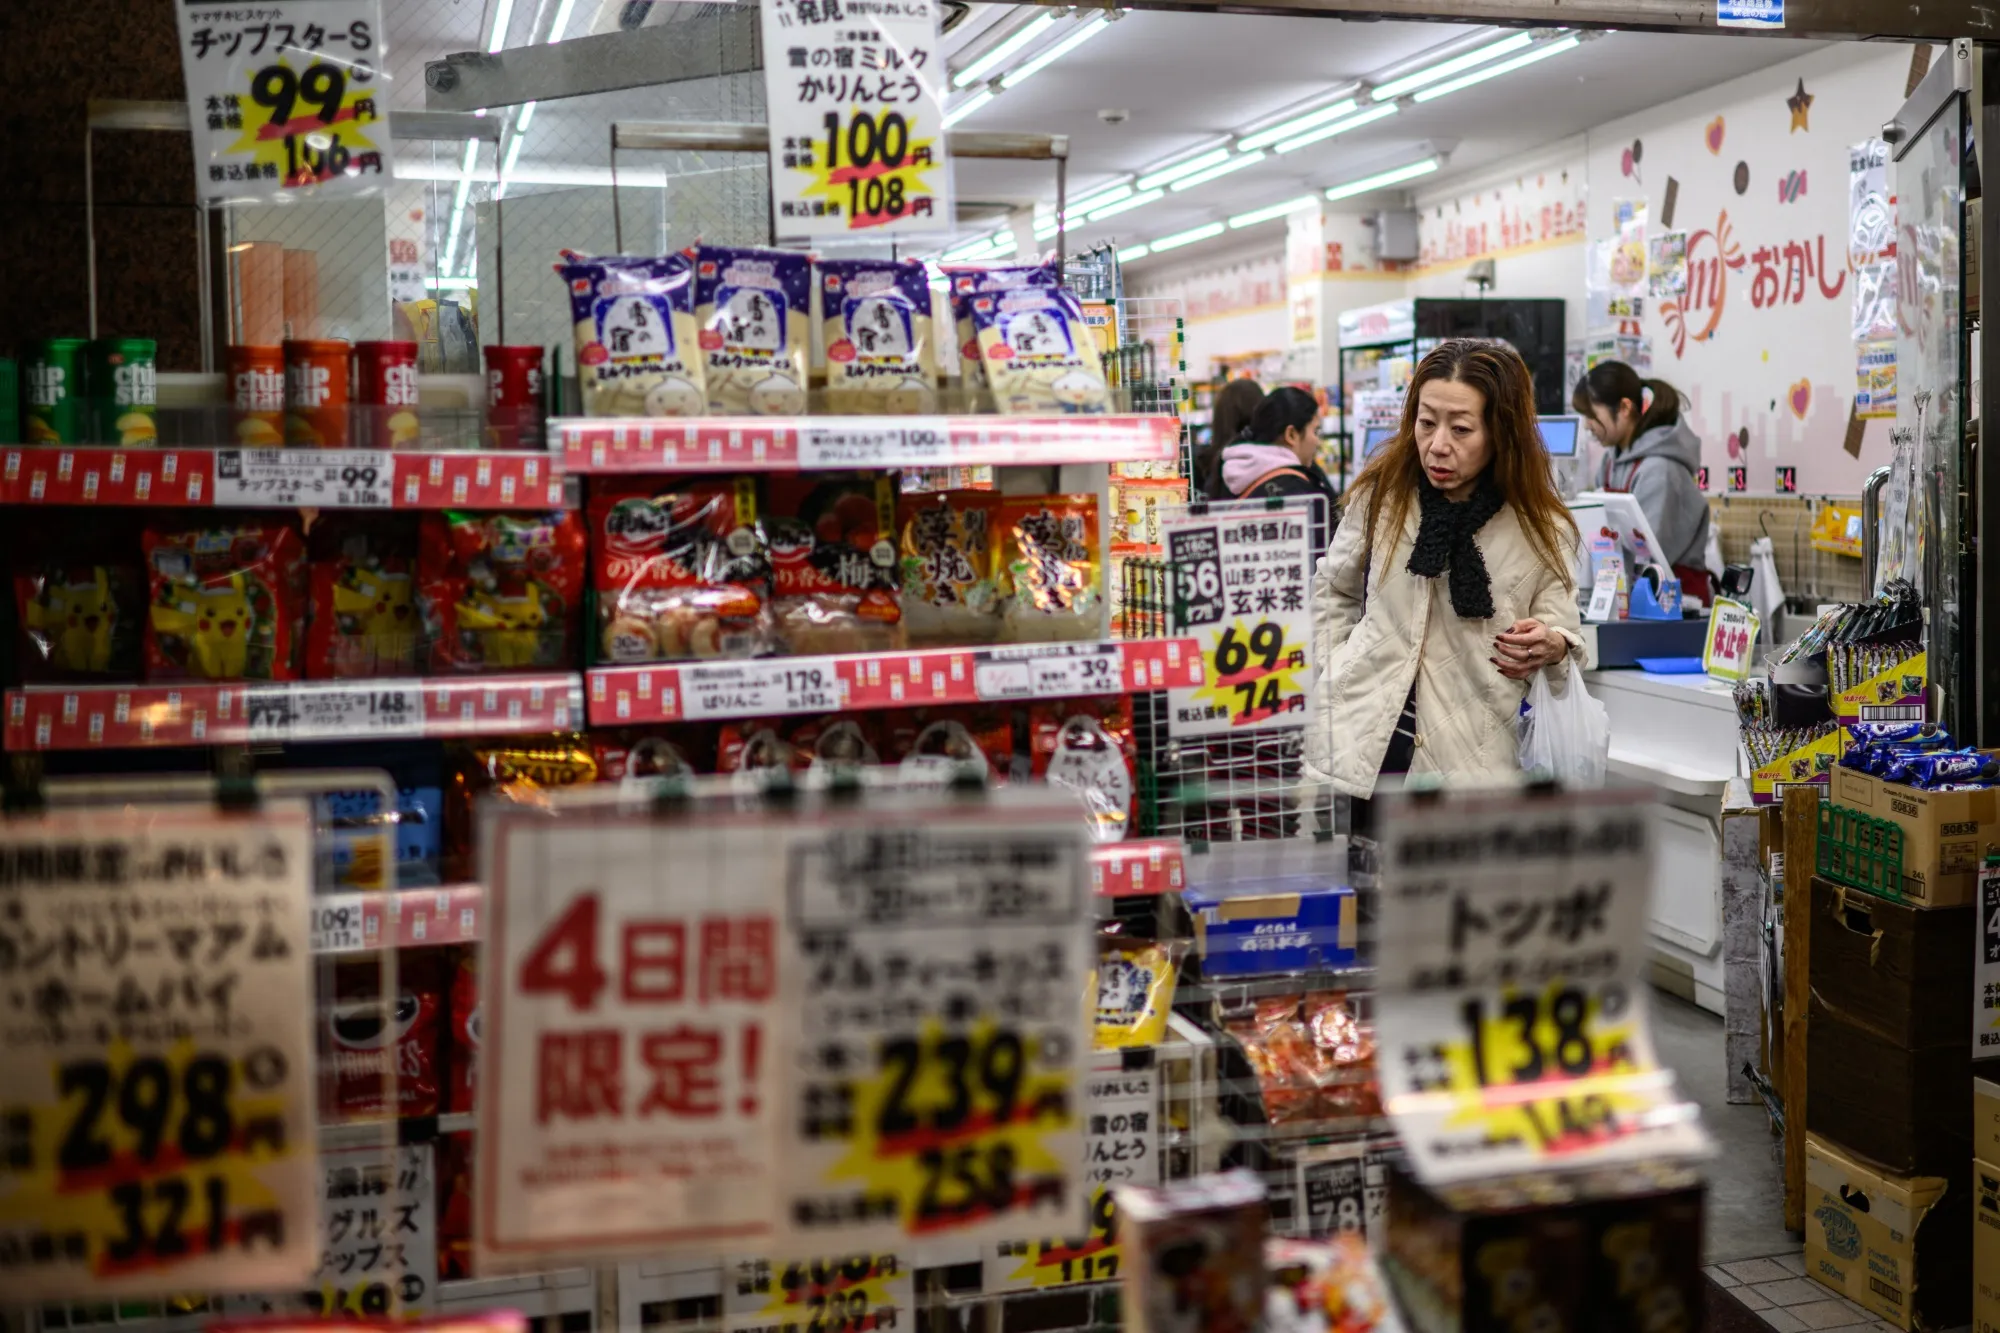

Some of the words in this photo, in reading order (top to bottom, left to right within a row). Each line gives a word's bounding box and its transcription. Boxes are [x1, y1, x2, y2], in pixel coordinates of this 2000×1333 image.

[190, 20, 372, 59] チップスターS
[798, 74, 922, 103] かりんとう
[1751, 234, 1846, 309] おかし
[1230, 585, 1304, 616] 玄米茶
[1892, 800, 1918, 816] 50836
[1942, 822, 1977, 834] 50836
[517, 888, 782, 1015] 4日間
